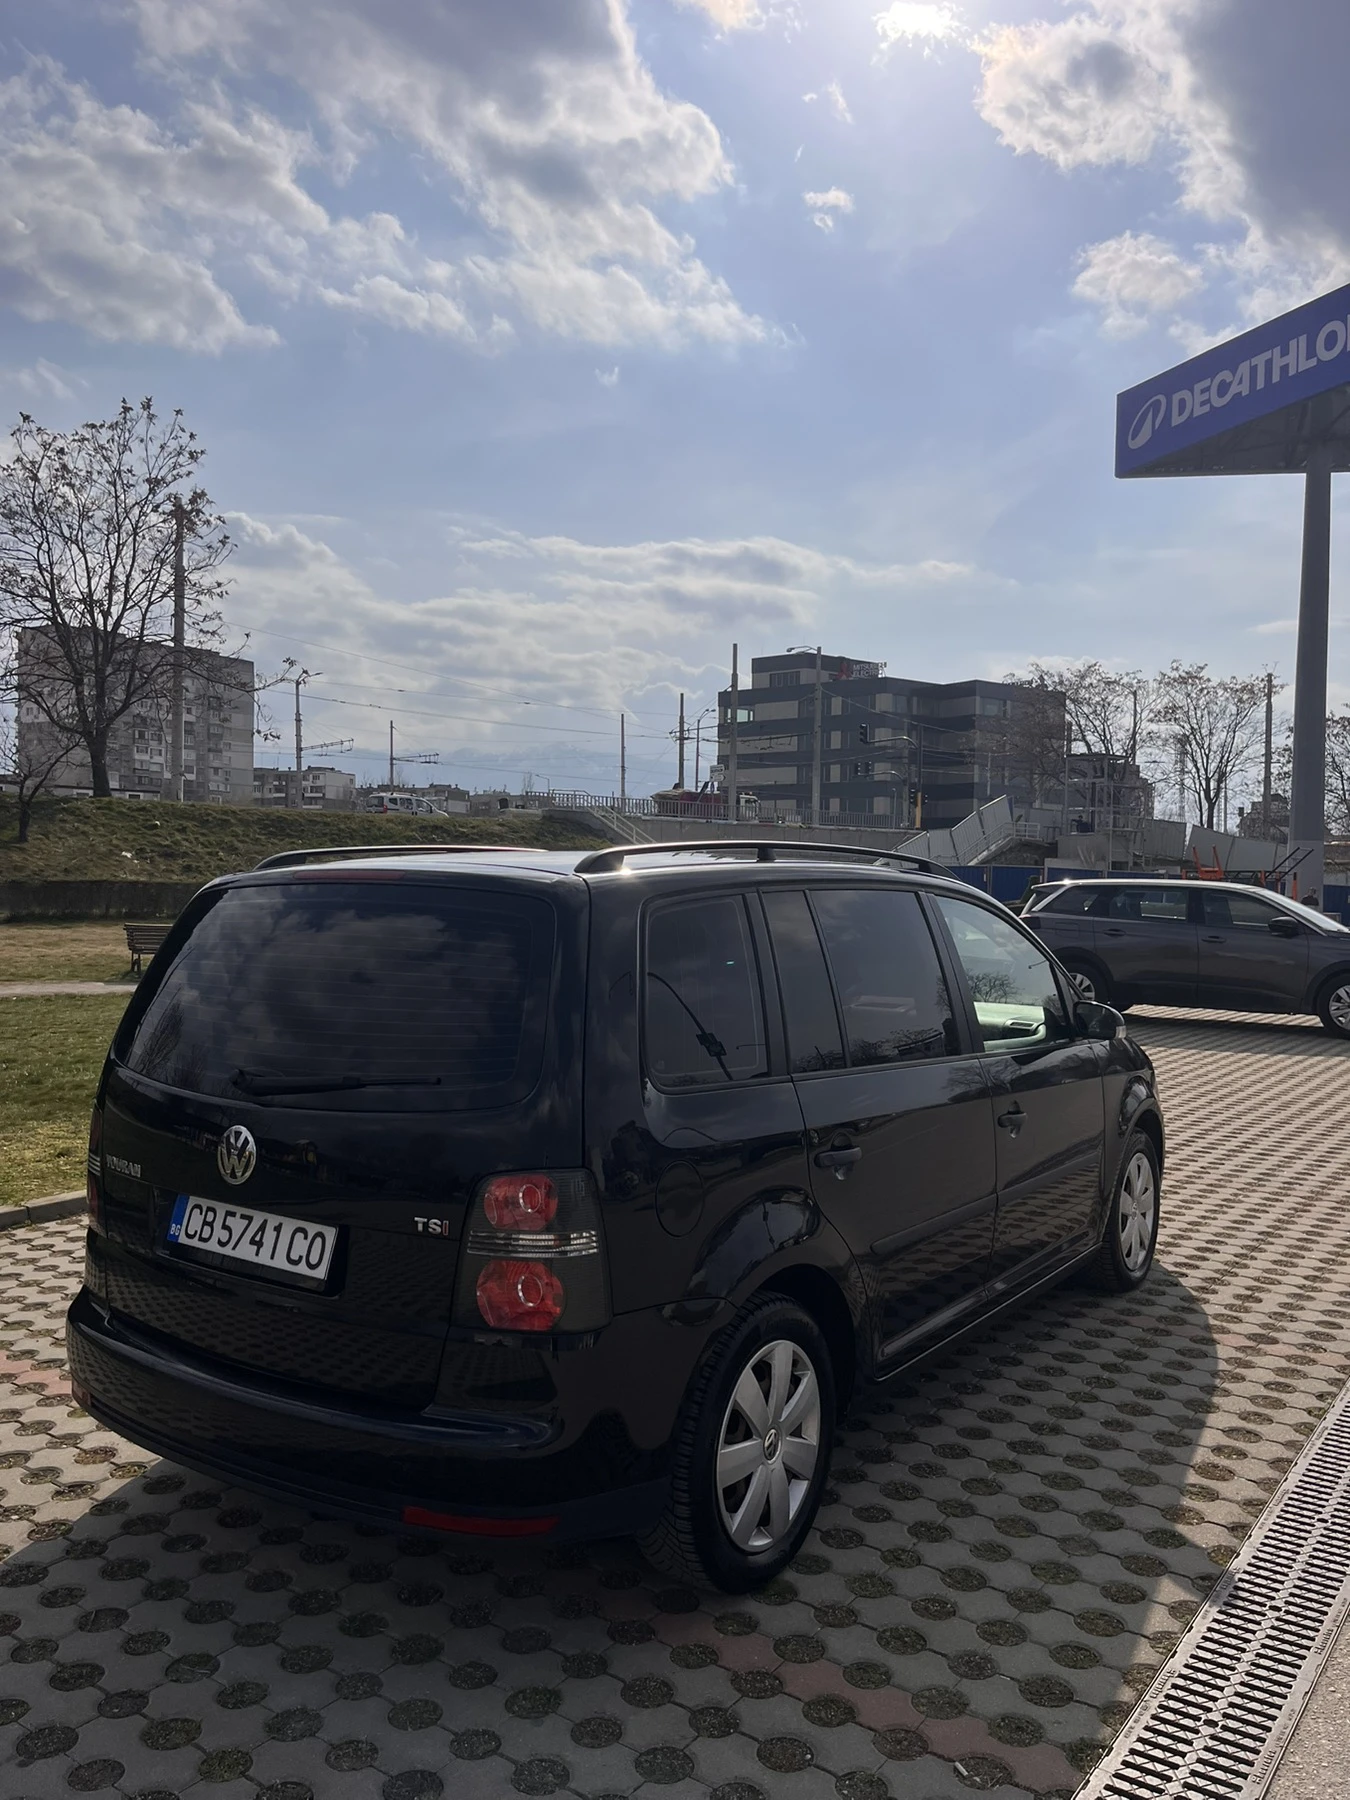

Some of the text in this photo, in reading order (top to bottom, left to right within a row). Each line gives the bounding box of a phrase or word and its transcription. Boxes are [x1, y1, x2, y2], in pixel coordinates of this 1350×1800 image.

[1171, 313, 1350, 427] DECATHLO
[170, 1223, 181, 1236] BG
[183, 1203, 326, 1271] CB5741CO
[414, 1216, 449, 1236] TSI
